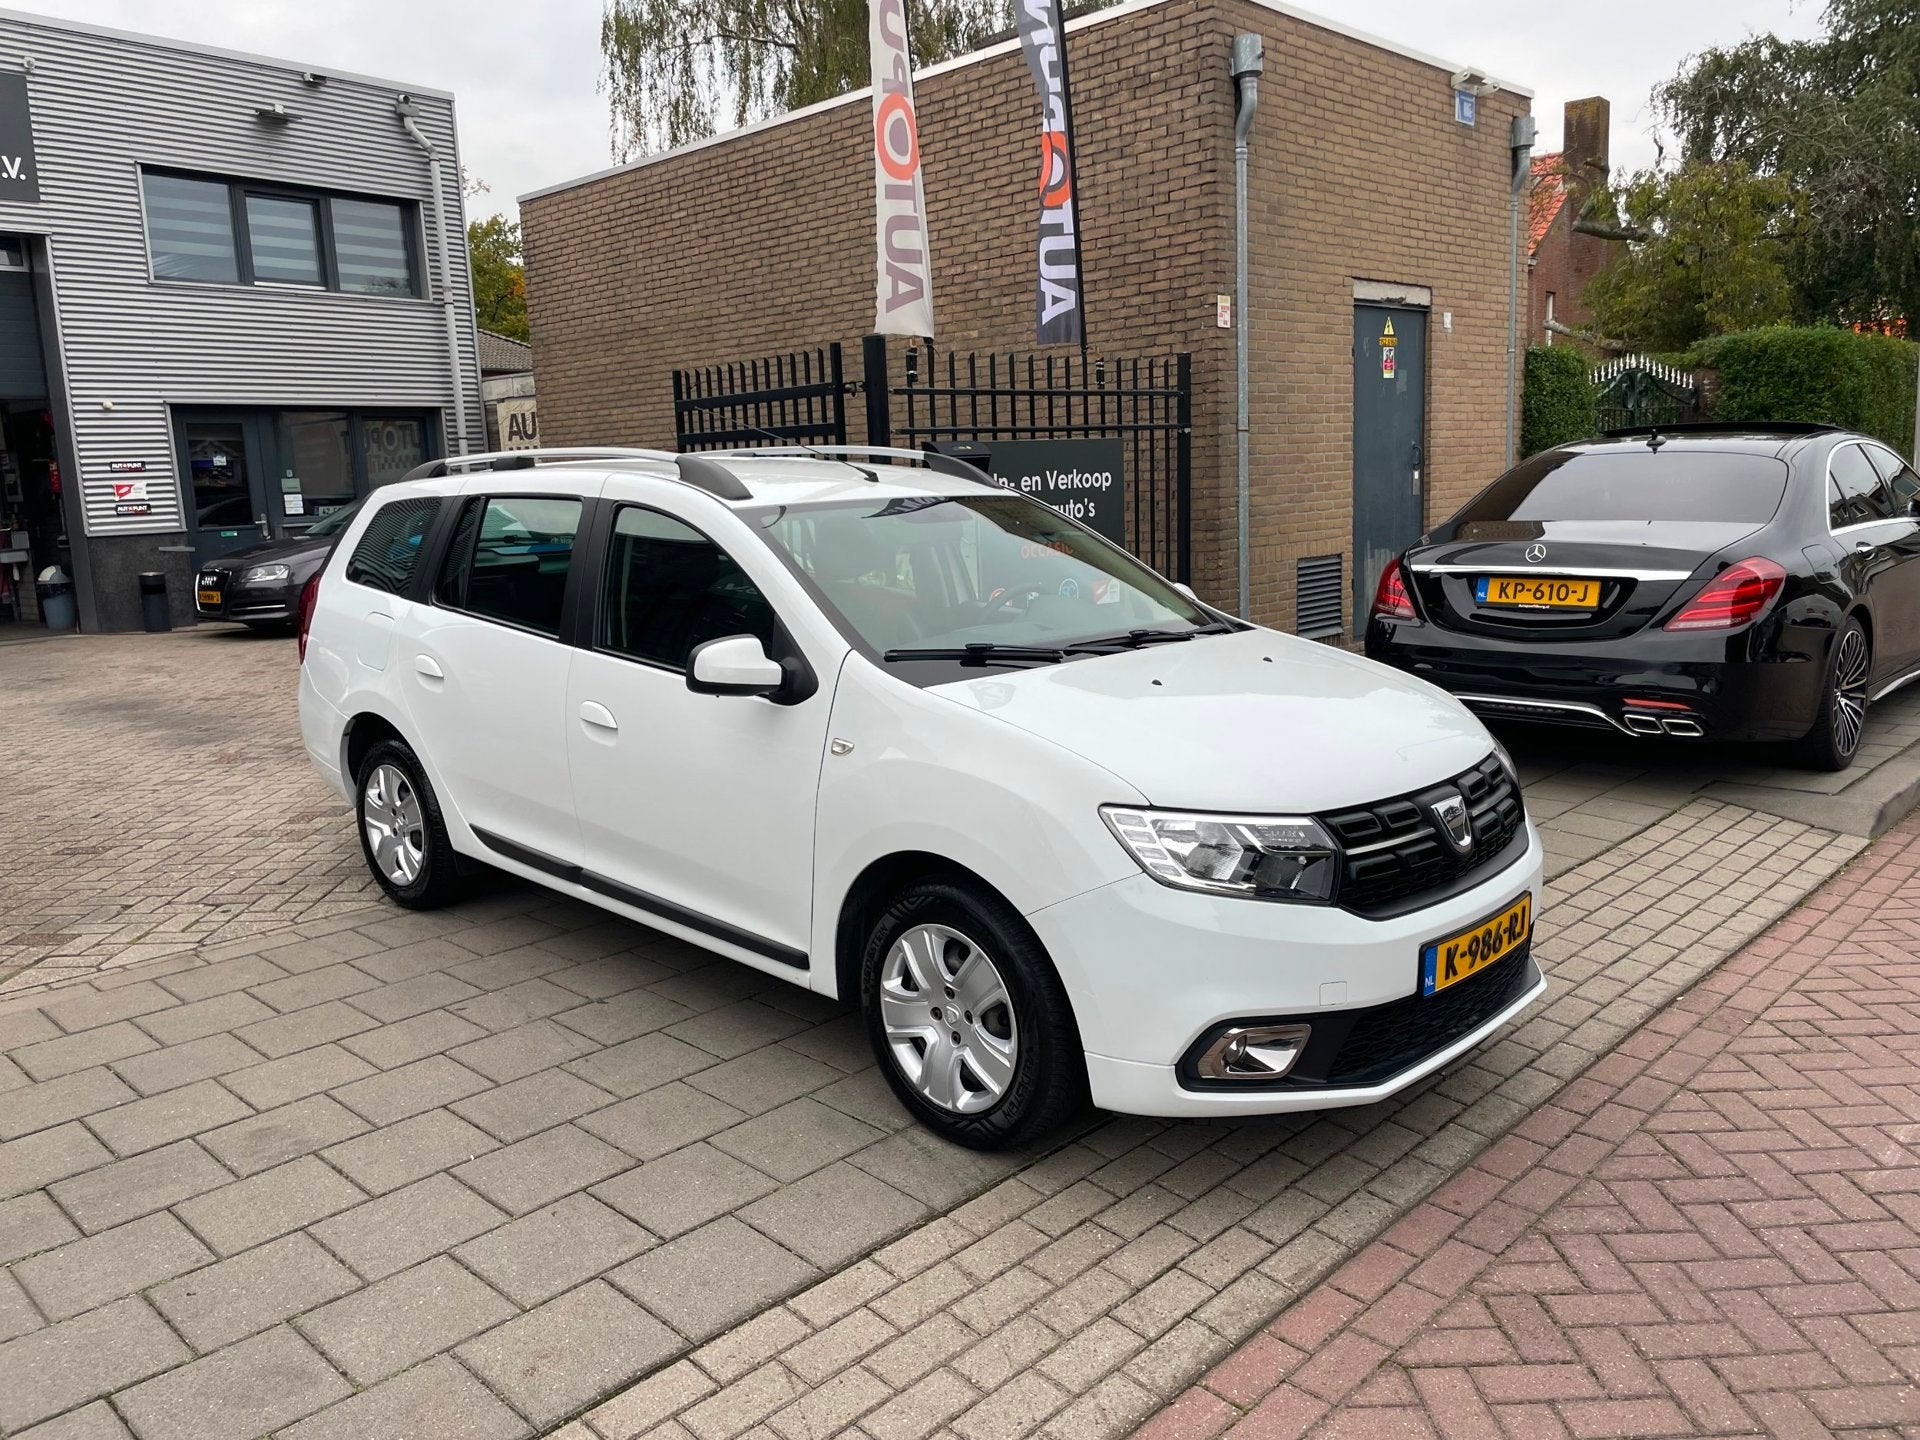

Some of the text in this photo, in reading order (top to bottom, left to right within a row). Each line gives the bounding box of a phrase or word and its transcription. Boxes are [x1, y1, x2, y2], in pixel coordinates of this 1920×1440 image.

[508, 412, 537, 441] AU
[1020, 475, 1042, 492] en
[1045, 469, 1112, 492] Verkoop
[1498, 582, 1589, 603] KP-610-J
[1445, 905, 1527, 981] K-986-RJ
[1424, 976, 1435, 988] NL
